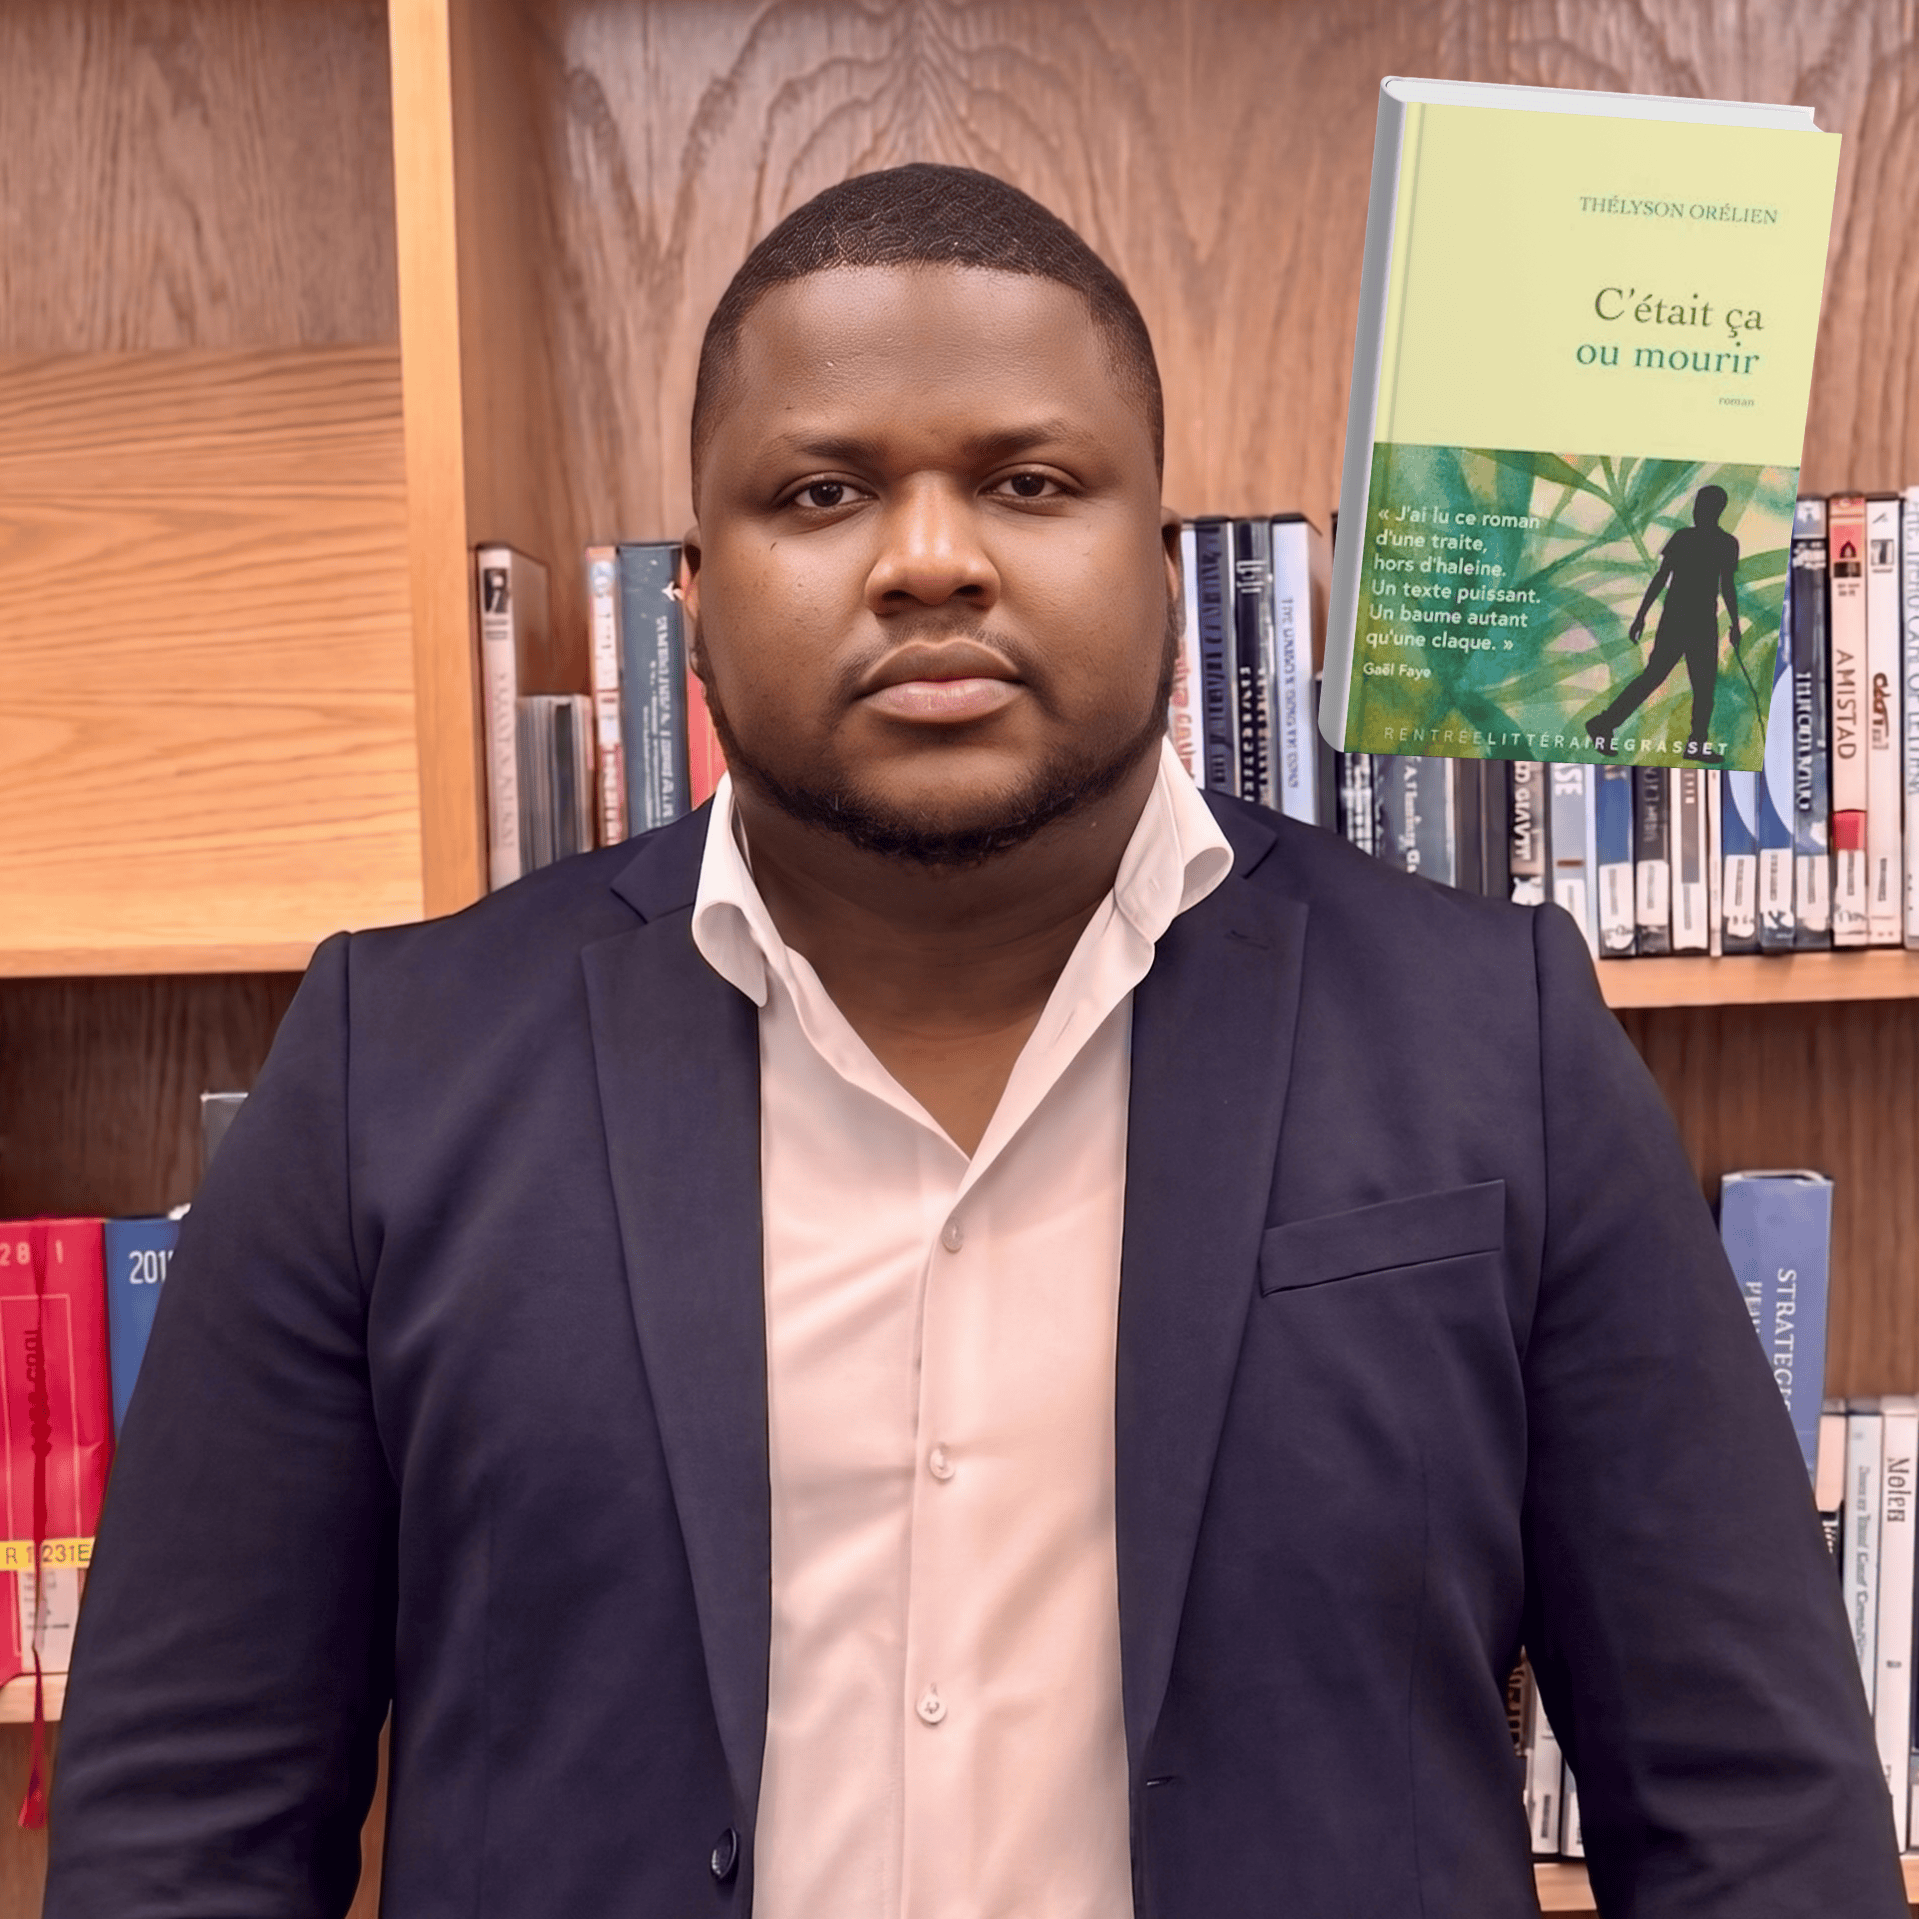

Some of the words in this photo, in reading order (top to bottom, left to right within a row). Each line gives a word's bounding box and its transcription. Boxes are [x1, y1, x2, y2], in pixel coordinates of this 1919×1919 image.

[1579, 194, 1685, 218] THÉLYSON
[1689, 202, 1779, 225] ORÉLIEN
[1594, 287, 1714, 327] C'était
[1725, 308, 1764, 338] ça
[1576, 343, 1620, 366] ou
[1634, 340, 1760, 375] mourir
[1718, 396, 1755, 408] roman
[1395, 504, 1427, 523] J'ai
[1433, 505, 1450, 524] lu
[1455, 512, 1477, 526] ce
[1482, 514, 1541, 529] roman
[1375, 528, 1426, 548] d'une
[1431, 533, 1489, 554] traite,
[1373, 552, 1415, 573] hors
[1420, 555, 1507, 578] d'haleine.
[1371, 578, 1397, 596] Un
[1403, 581, 1452, 600] texte
[1457, 584, 1541, 605] puissant.
[1369, 603, 1394, 621] Un
[1400, 603, 1462, 625] baume
[1467, 611, 1529, 628] autant
[1365, 629, 1427, 650] qu'une
[1431, 630, 1497, 654] claque.
[1362, 661, 1396, 677] Gaël
[1399, 663, 1433, 682] Faye
[1836, 649, 1858, 761] AMISTAD
[128, 1249, 175, 1285] 201
